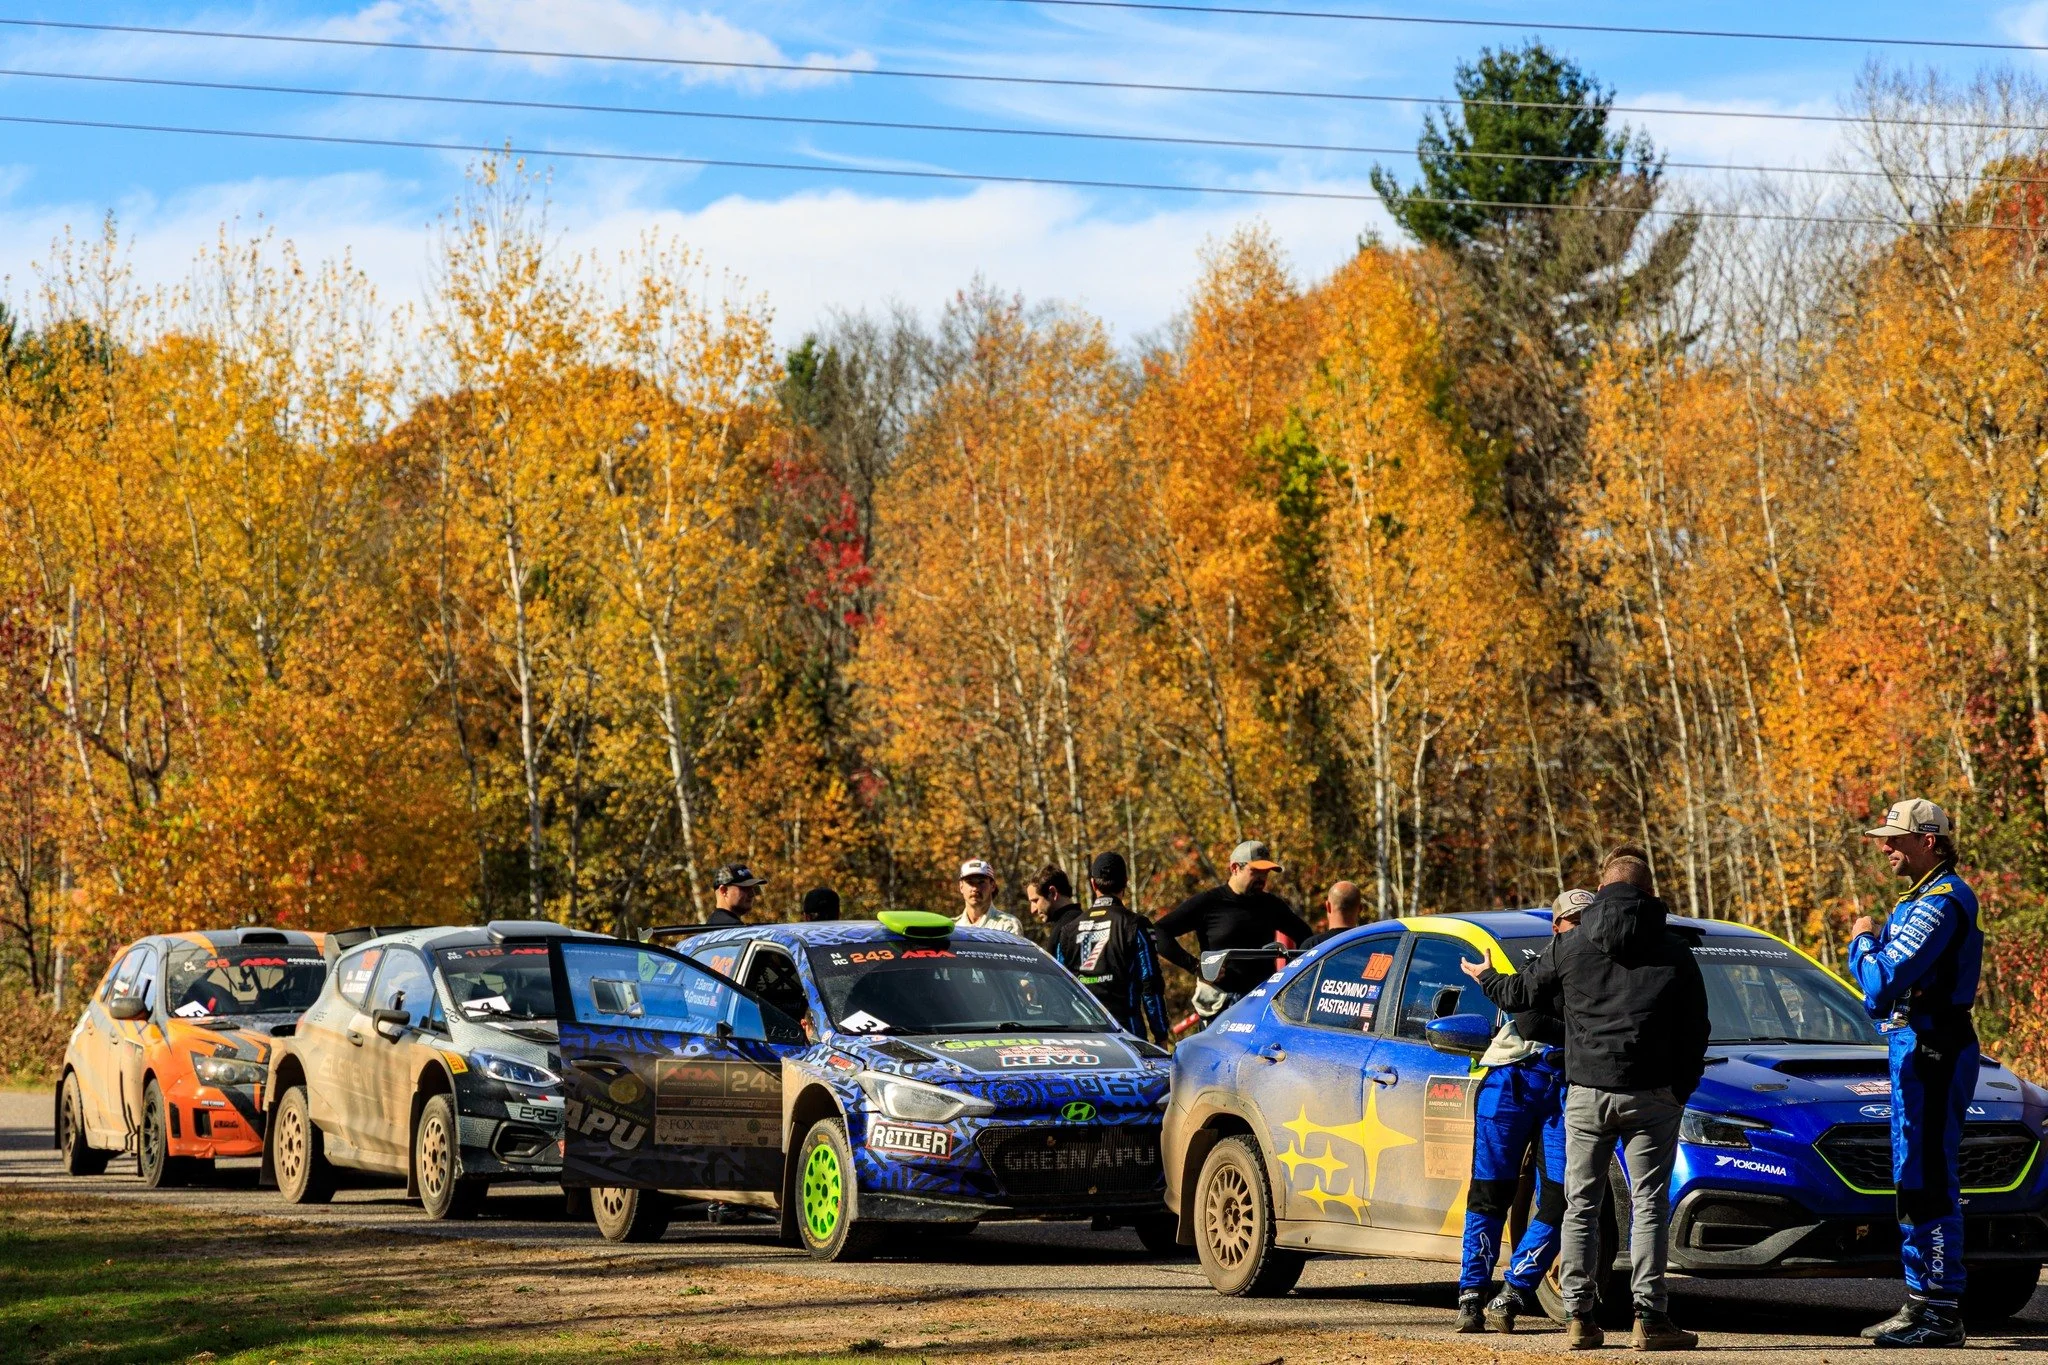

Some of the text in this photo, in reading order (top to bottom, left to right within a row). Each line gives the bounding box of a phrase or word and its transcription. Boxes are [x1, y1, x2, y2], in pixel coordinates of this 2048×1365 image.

[849, 950, 895, 964] 243
[901, 950, 957, 959] ARA
[956, 951, 1008, 959] AMERICAN
[1749, 949, 1788, 957] RALLY
[240, 957, 287, 967] ARA
[833, 958, 849, 966] RC
[1321, 979, 1368, 999] GELSOMINO
[1316, 997, 1361, 1017] PASTRANA
[1227, 1022, 1256, 1034] SUBARU
[1002, 1054, 1100, 1066] REVO
[662, 1066, 721, 1082] ARA
[1428, 1083, 1465, 1101] ARA
[519, 1106, 558, 1122] ERS
[669, 1119, 695, 1130] FOX
[871, 1125, 947, 1155] ROTTLER
[1003, 1146, 1155, 1171] GREEN APU
[1732, 1157, 1787, 1177] YOKOHAMA
